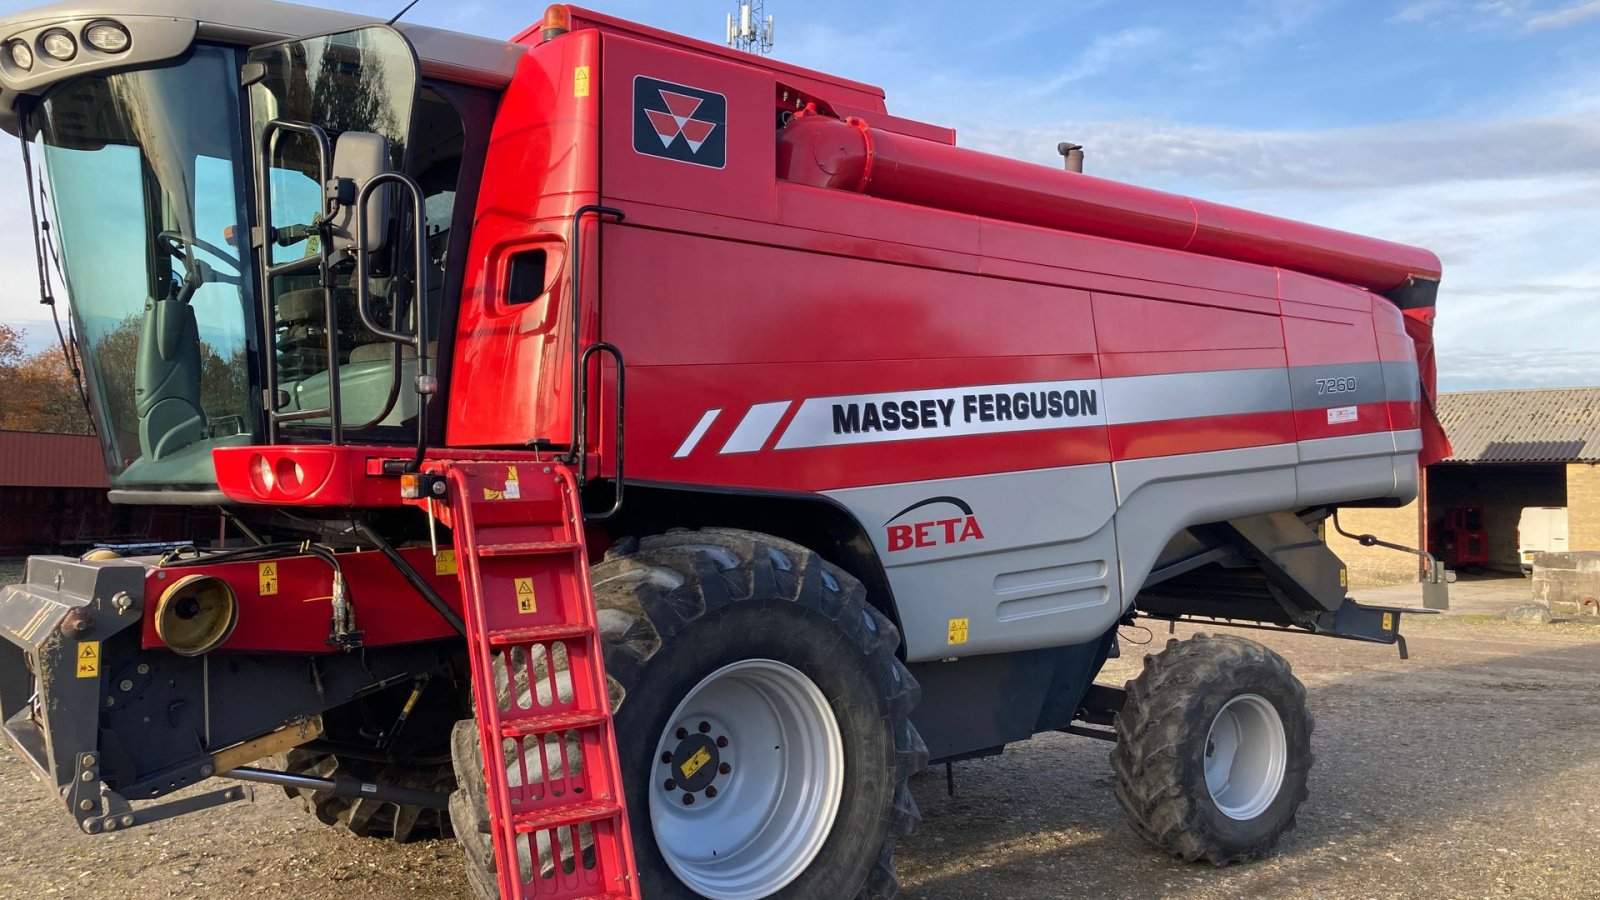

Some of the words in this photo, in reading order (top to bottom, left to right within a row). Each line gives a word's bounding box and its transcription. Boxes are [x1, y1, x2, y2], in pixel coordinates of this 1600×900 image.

[1316, 377, 1357, 395] 7260
[832, 399, 955, 434] MASSEY
[963, 389, 1098, 423] FERGUSON
[887, 516, 984, 552] BETA
